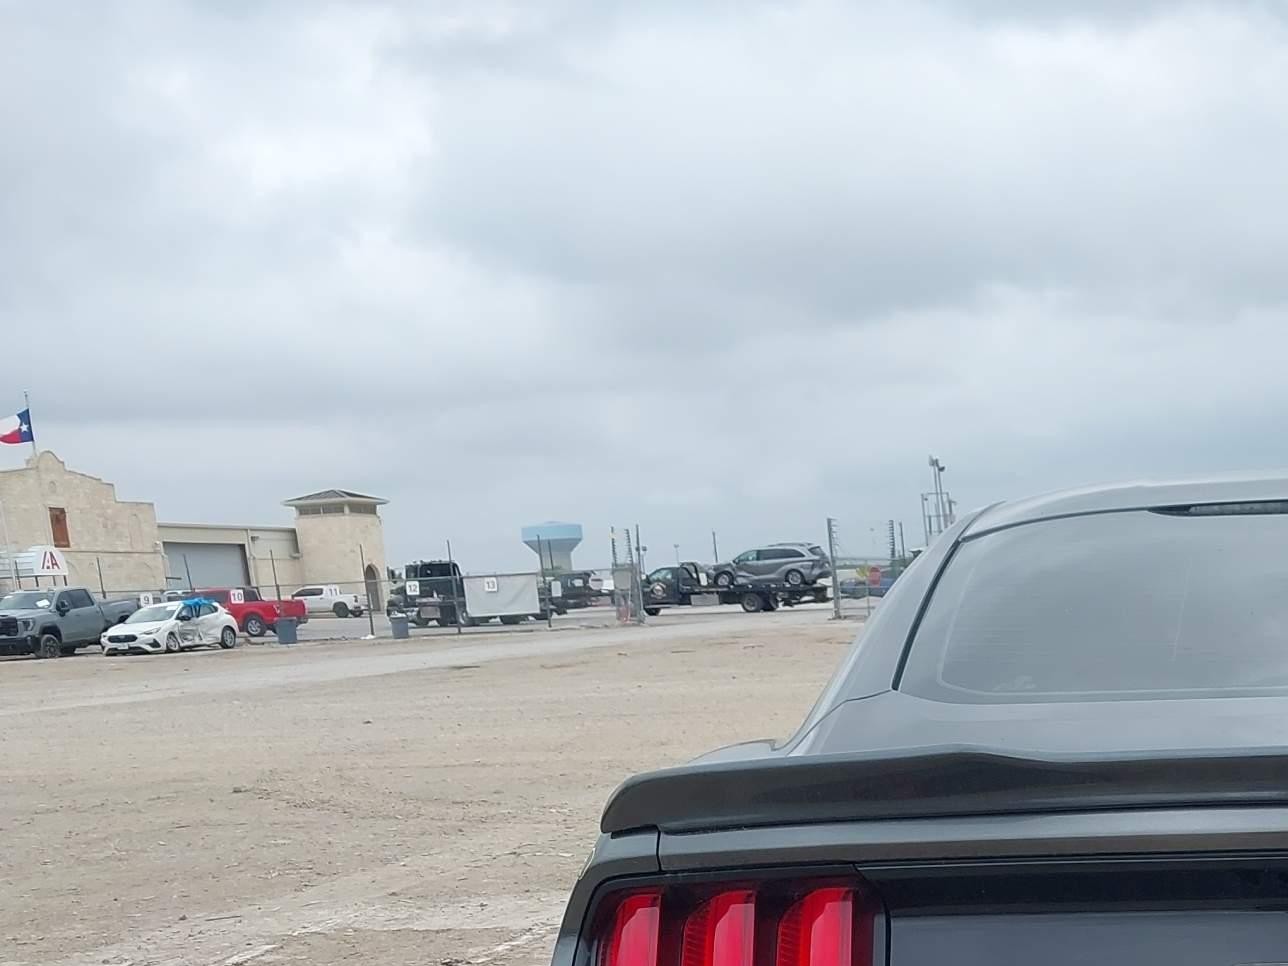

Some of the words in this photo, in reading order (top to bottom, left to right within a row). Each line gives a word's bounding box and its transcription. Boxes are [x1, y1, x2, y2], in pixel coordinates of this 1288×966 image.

[408, 584, 418, 593] 12
[486, 580, 496, 589] 13
[232, 593, 242, 602] 10
